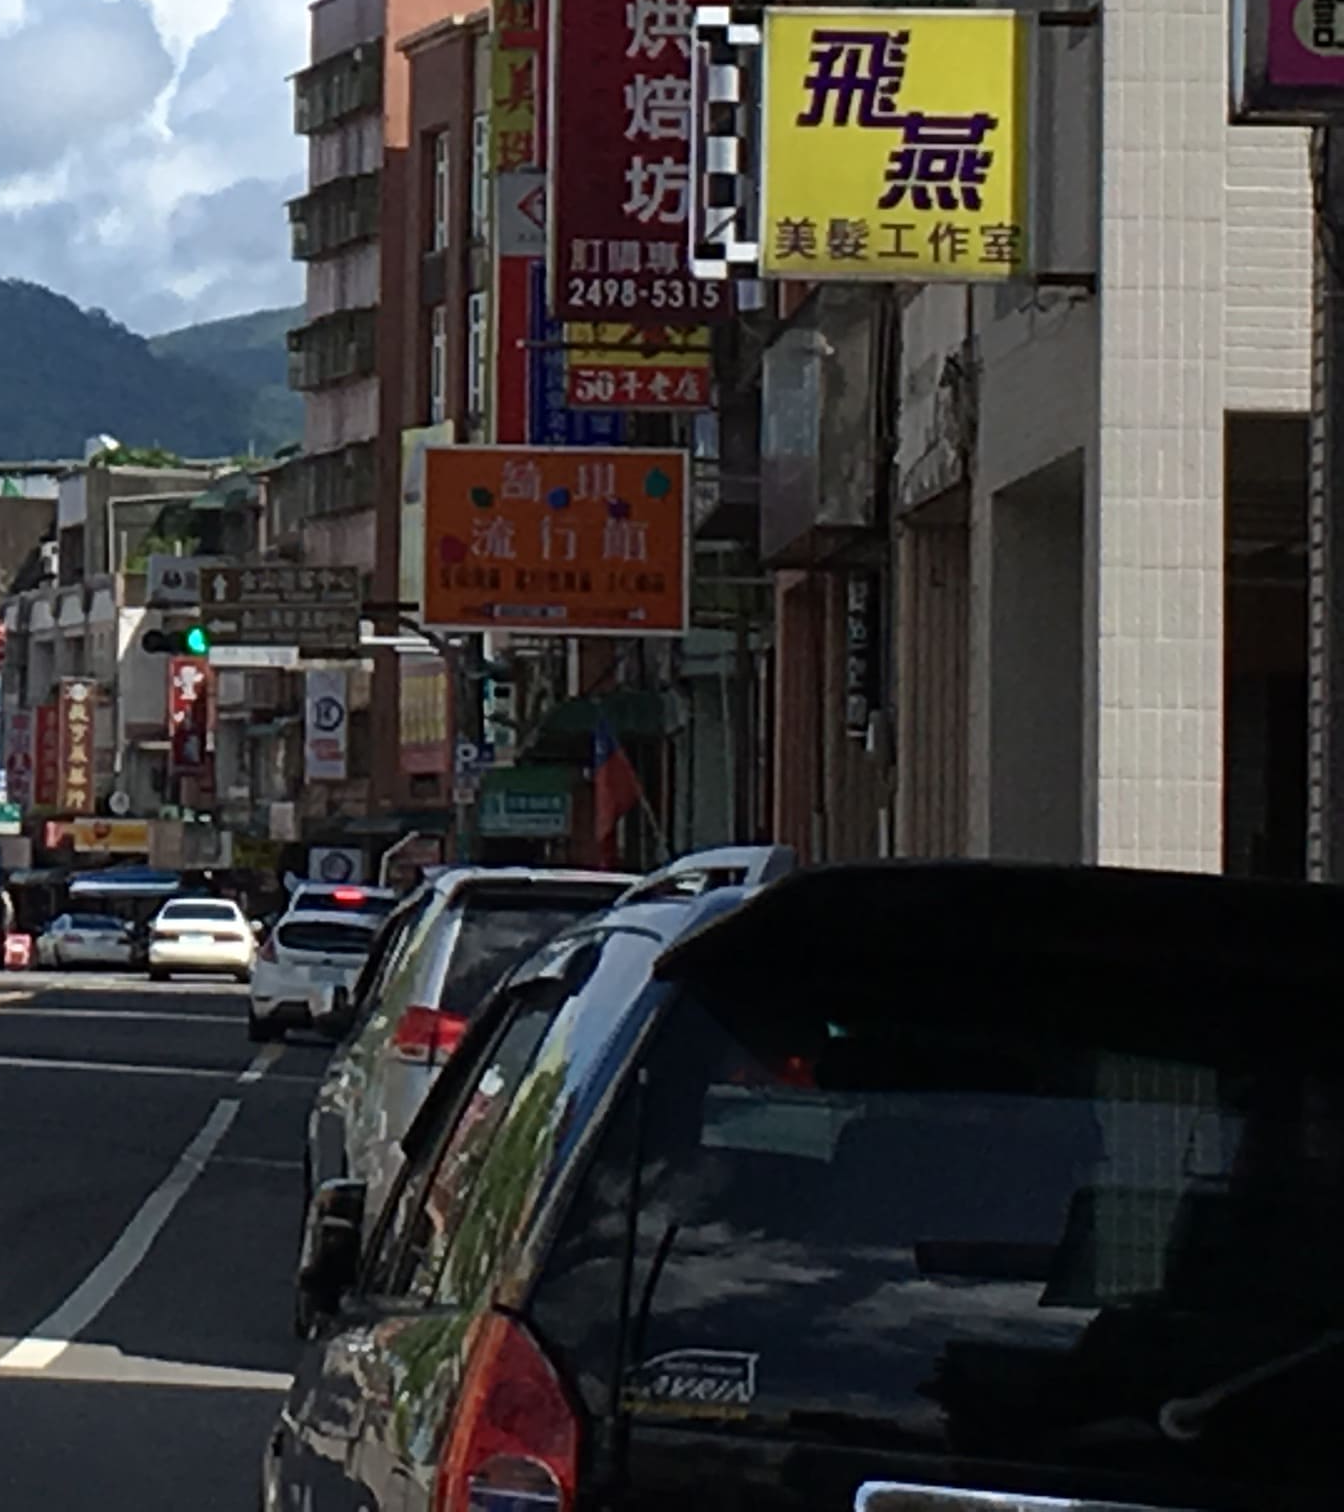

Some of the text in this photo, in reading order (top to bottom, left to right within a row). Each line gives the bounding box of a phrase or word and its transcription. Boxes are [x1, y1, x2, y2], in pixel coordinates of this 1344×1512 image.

[796, 29, 999, 212] 飛燕
[569, 238, 688, 276] 訂購專
[775, 216, 1022, 265] 美髮工作室
[567, 276, 721, 309] 2498-5315
